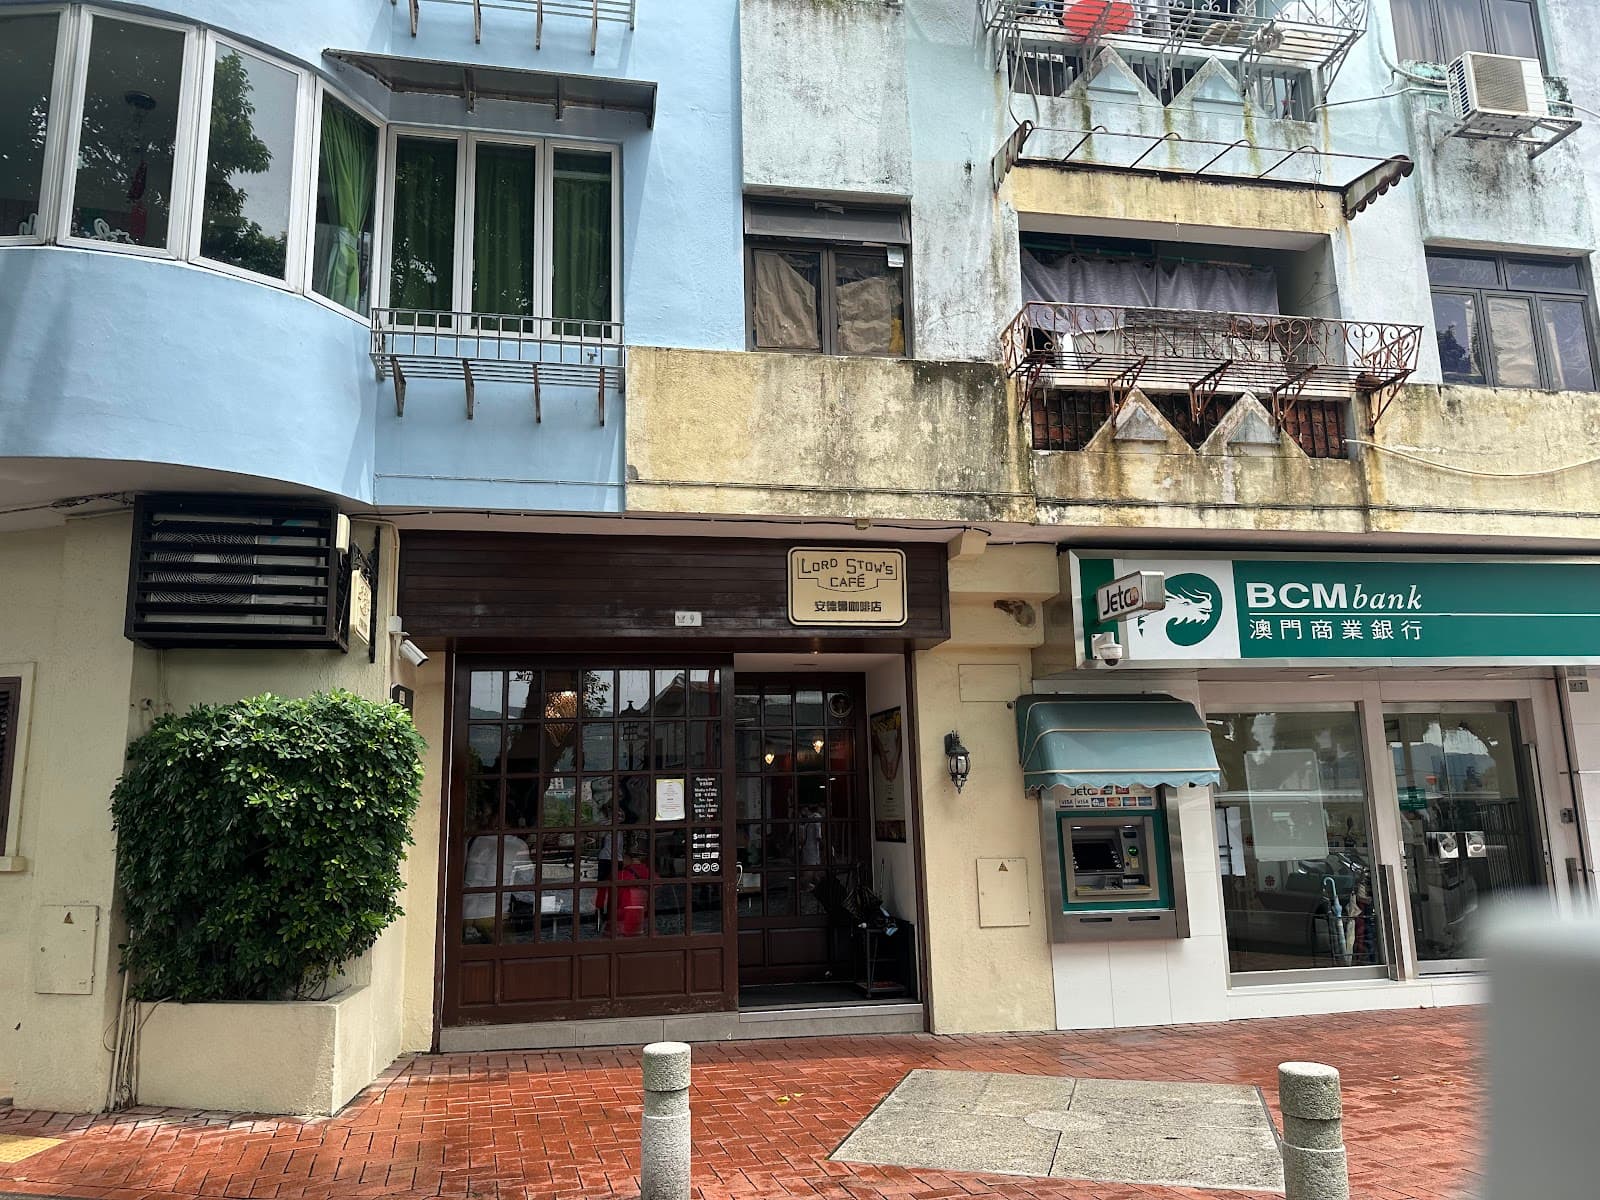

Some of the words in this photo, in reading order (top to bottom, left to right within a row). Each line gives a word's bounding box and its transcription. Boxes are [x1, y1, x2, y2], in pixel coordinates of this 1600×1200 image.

[802, 558, 838, 574] LORD
[846, 558, 894, 575] STOW'S
[830, 574, 866, 588] CAFÉ
[1246, 582, 1348, 609] BCM
[1352, 584, 1422, 610] bank
[1249, 618, 1423, 641] 澳門商業銀行
